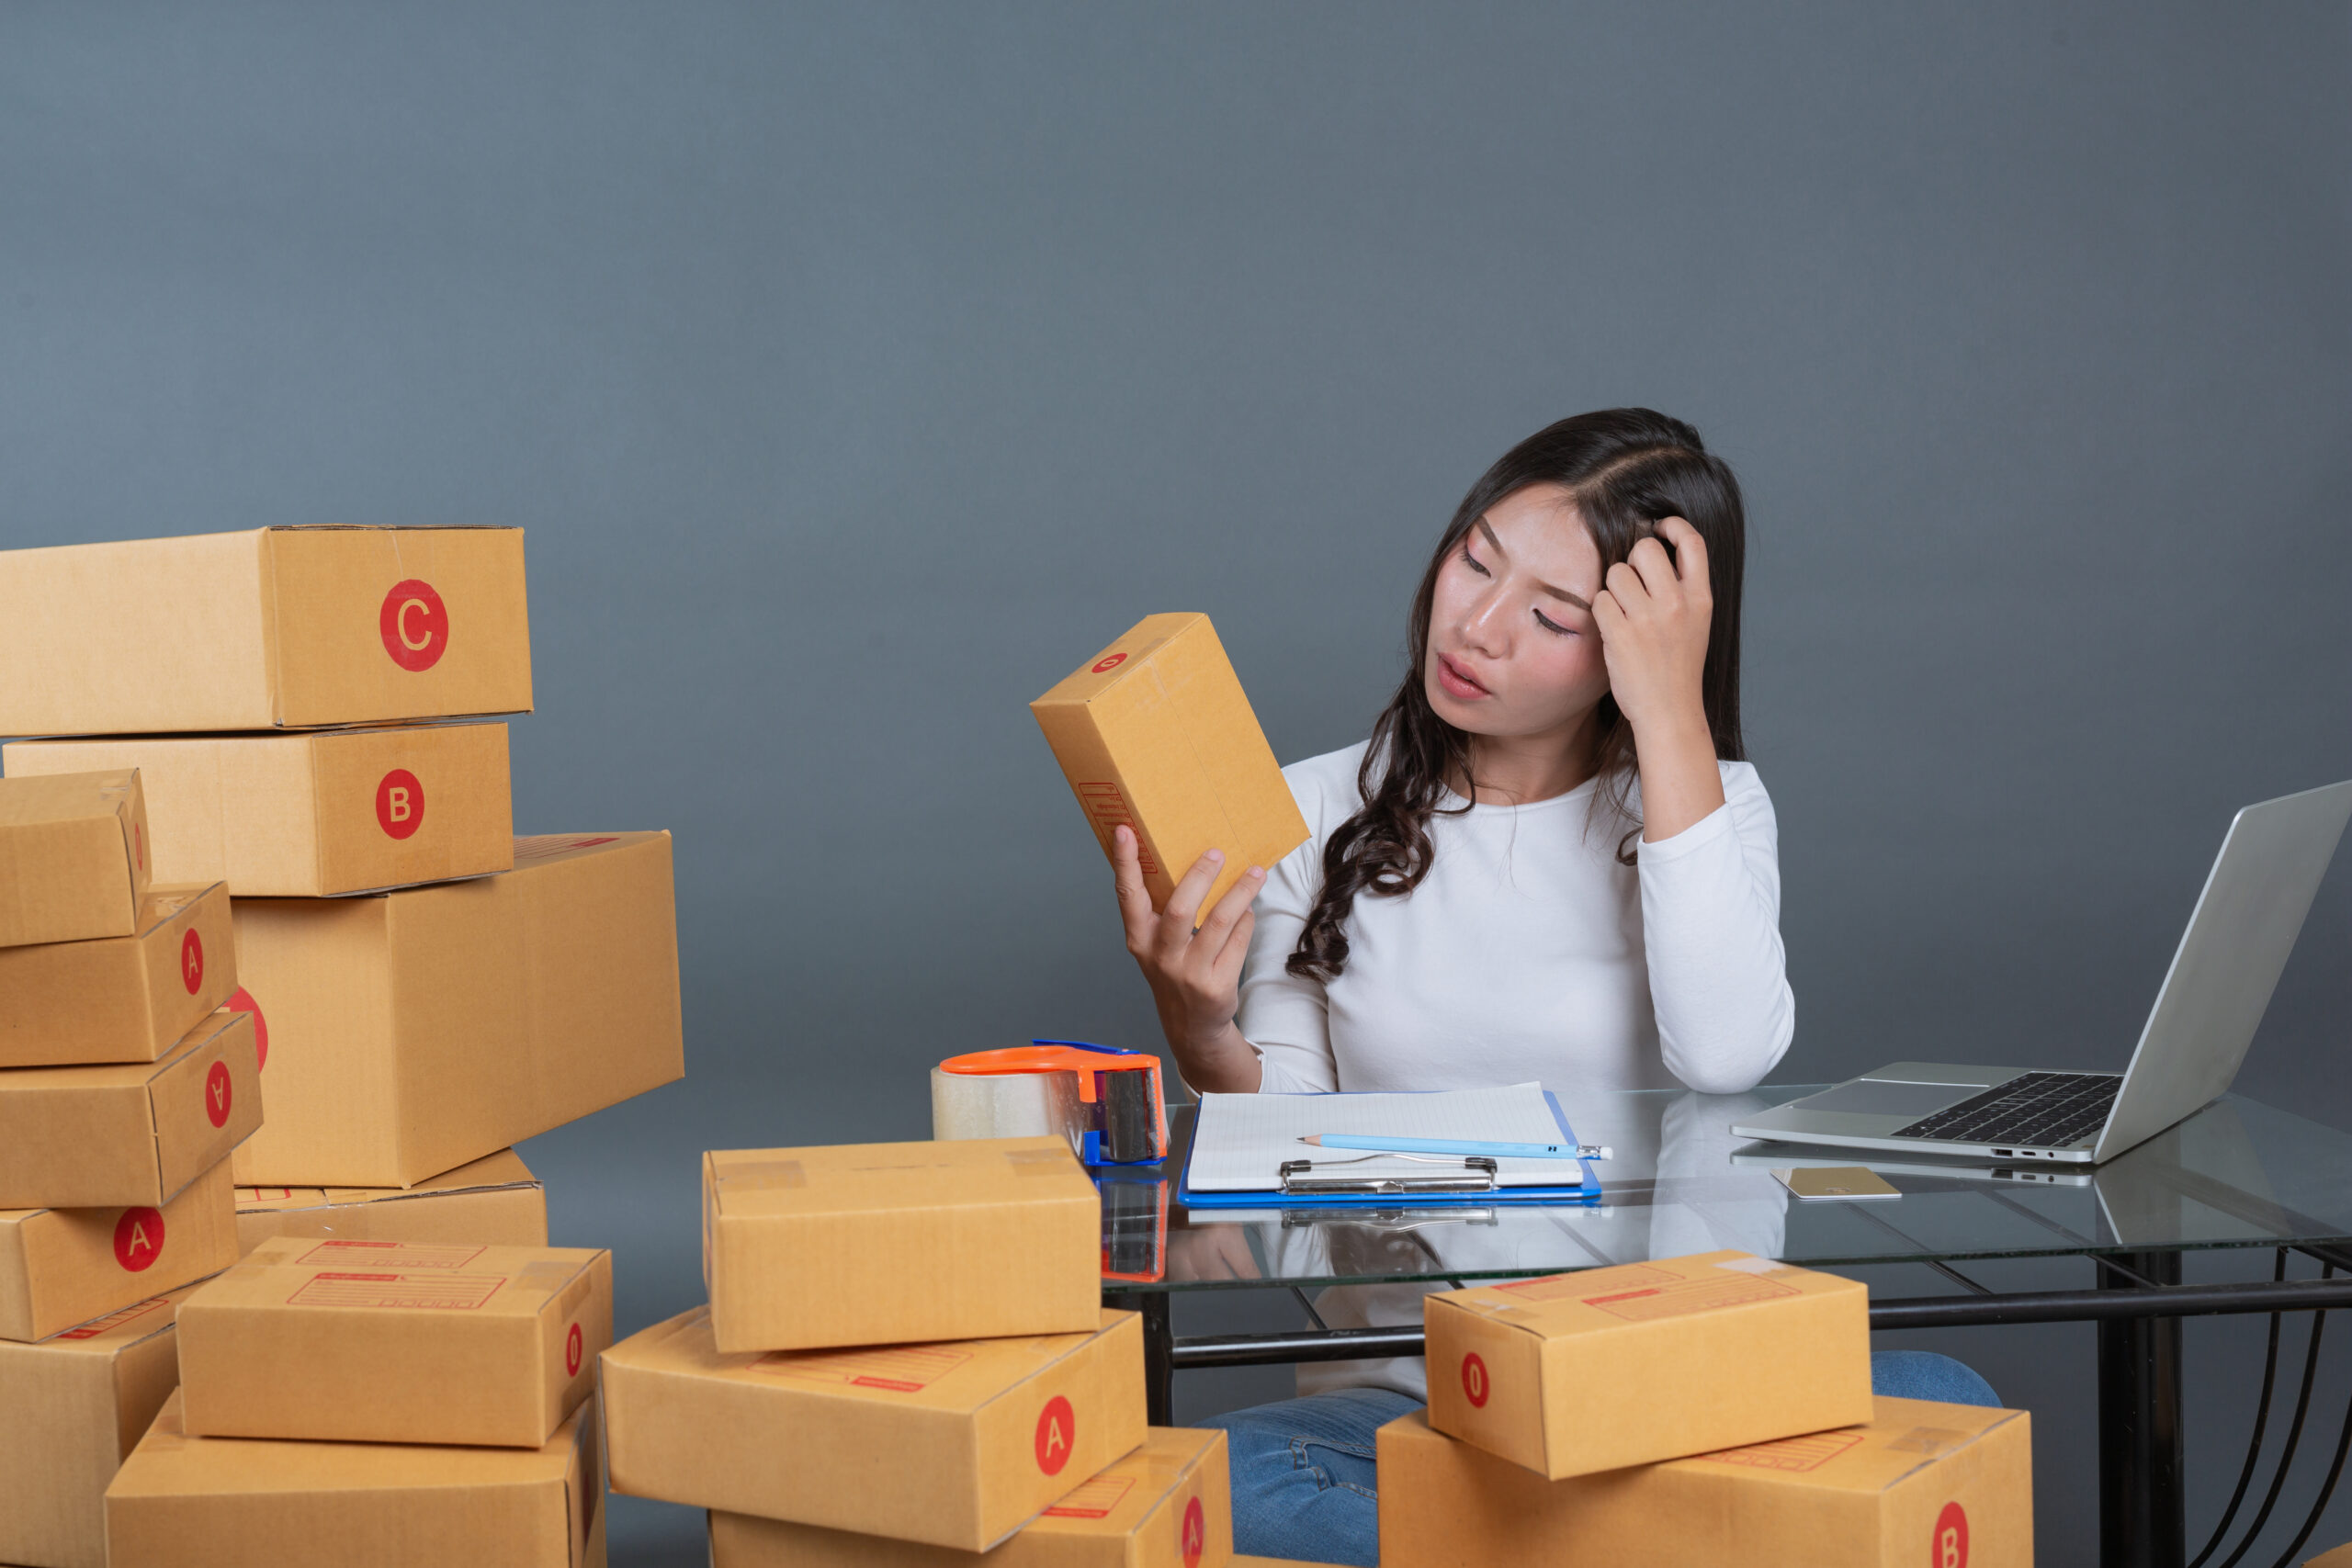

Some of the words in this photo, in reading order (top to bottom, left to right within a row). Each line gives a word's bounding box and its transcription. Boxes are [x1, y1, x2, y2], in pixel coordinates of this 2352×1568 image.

[398, 598, 433, 651] C
[389, 786, 411, 822] B
[188, 945, 198, 979] A
[211, 1077, 223, 1111] A
[128, 1221, 152, 1257] A
[1046, 1416, 1065, 1459] A
[1188, 1517, 1199, 1556] A
[1941, 1527, 1959, 1568] B
